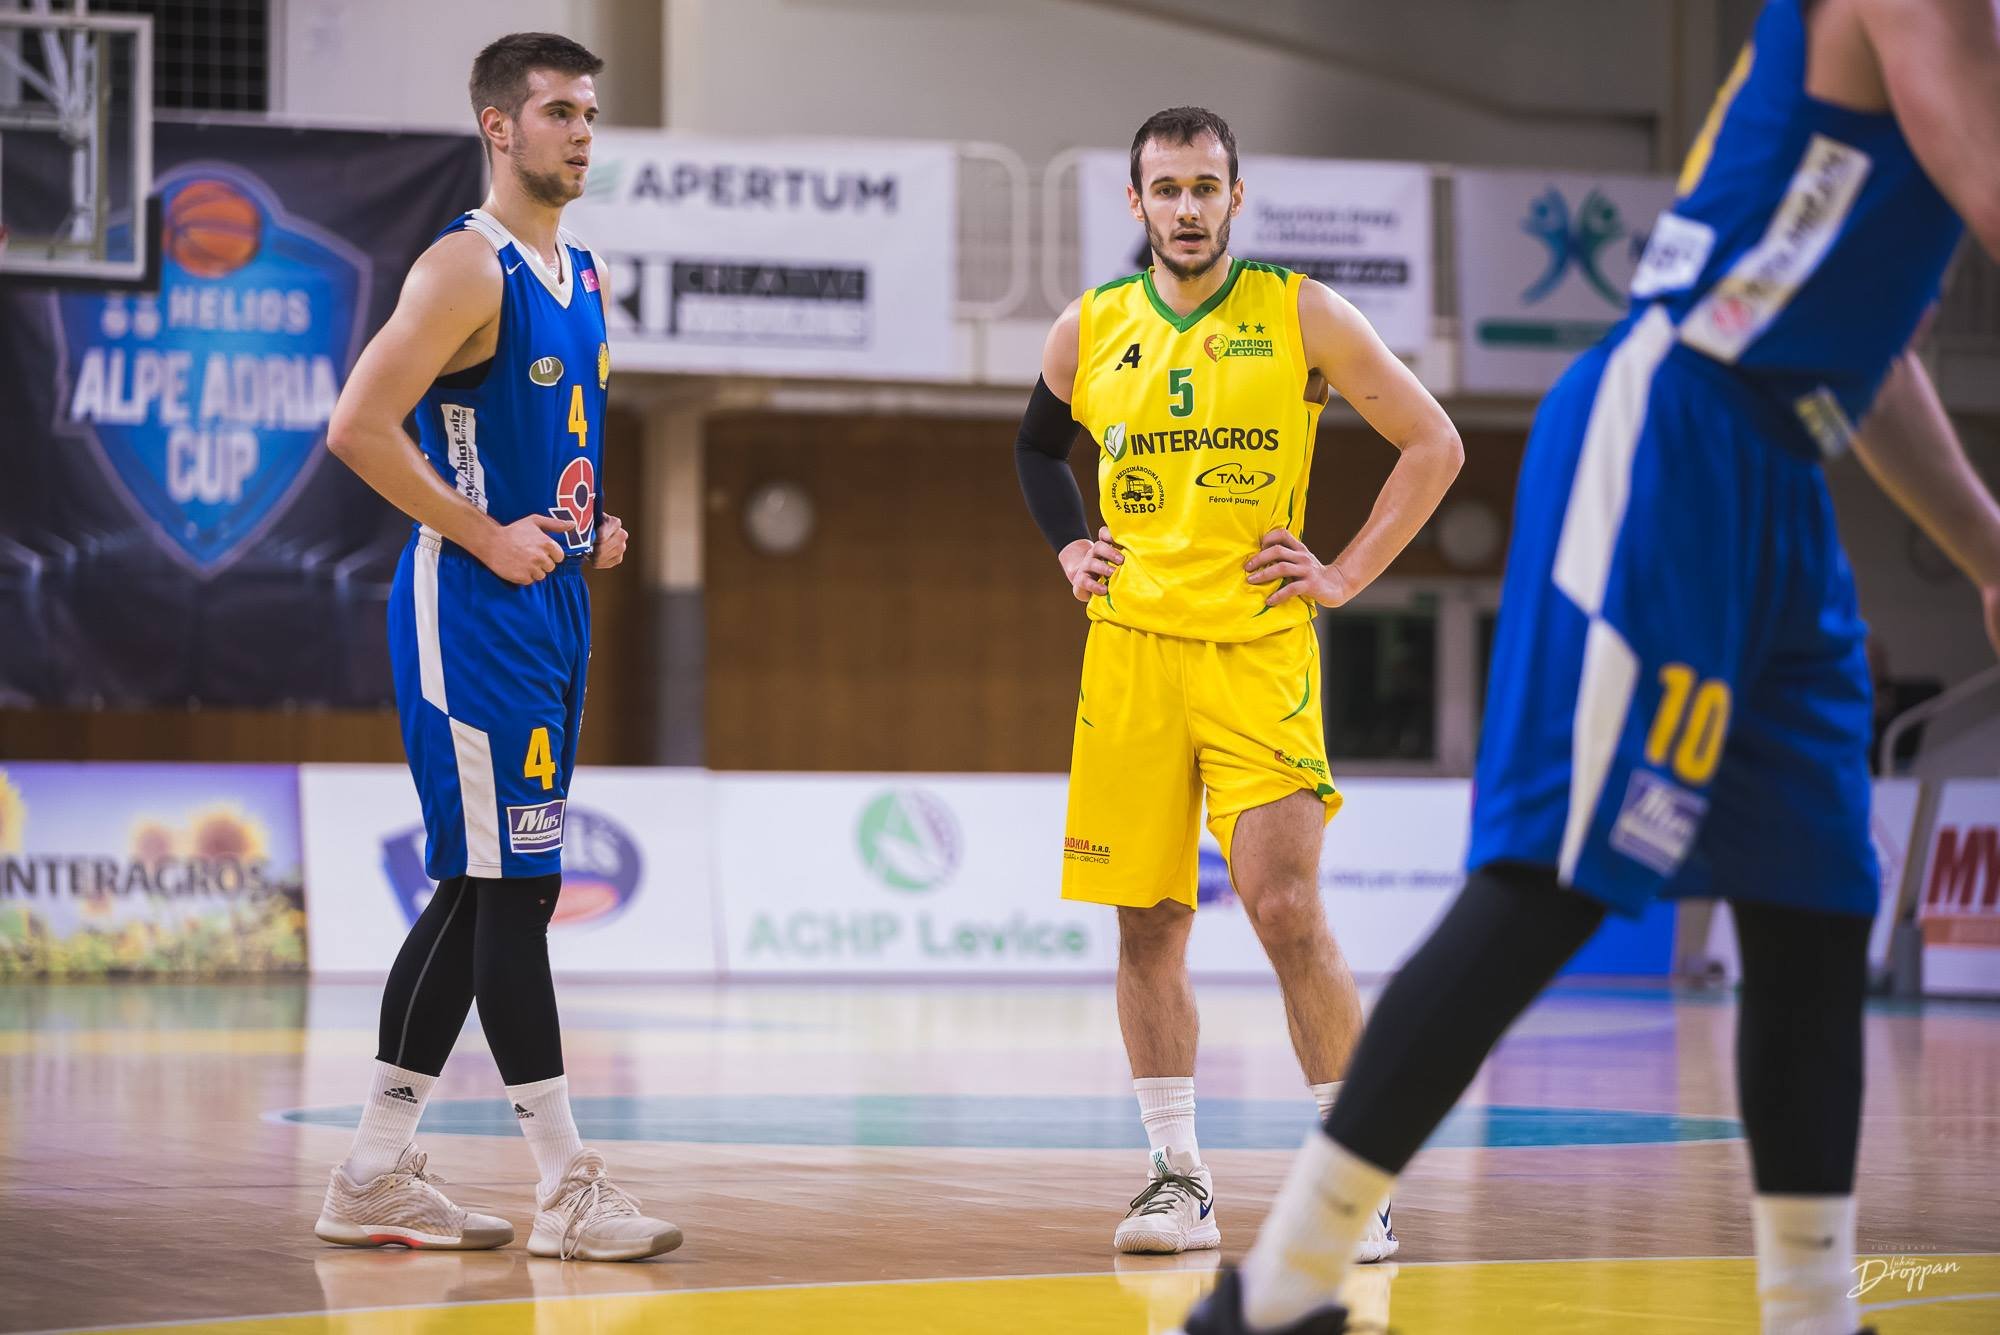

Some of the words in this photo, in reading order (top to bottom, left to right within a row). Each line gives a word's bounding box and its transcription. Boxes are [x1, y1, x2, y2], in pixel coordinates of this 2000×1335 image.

[631, 164, 898, 213] APERTUM
[168, 285, 310, 334] HELIOS
[71, 347, 192, 426] ALPE
[202, 350, 338, 430] ADRIA
[1168, 368, 1194, 418] 5
[568, 384, 587, 447] 4
[166, 427, 259, 504] CUP
[1130, 428, 1279, 456] INTERAGROS
[1217, 473, 1254, 485] TAM
[1234, 497, 1260, 506] pumpy
[1123, 502, 1156, 513] ŠEBO
[1645, 663, 1732, 785] 10
[524, 727, 556, 790] 4
[3, 855, 266, 899] NTERAGROS
[746, 911, 901, 956] ACHP
[916, 911, 1089, 957] Levice
[384, 1090, 418, 1104] adidas
